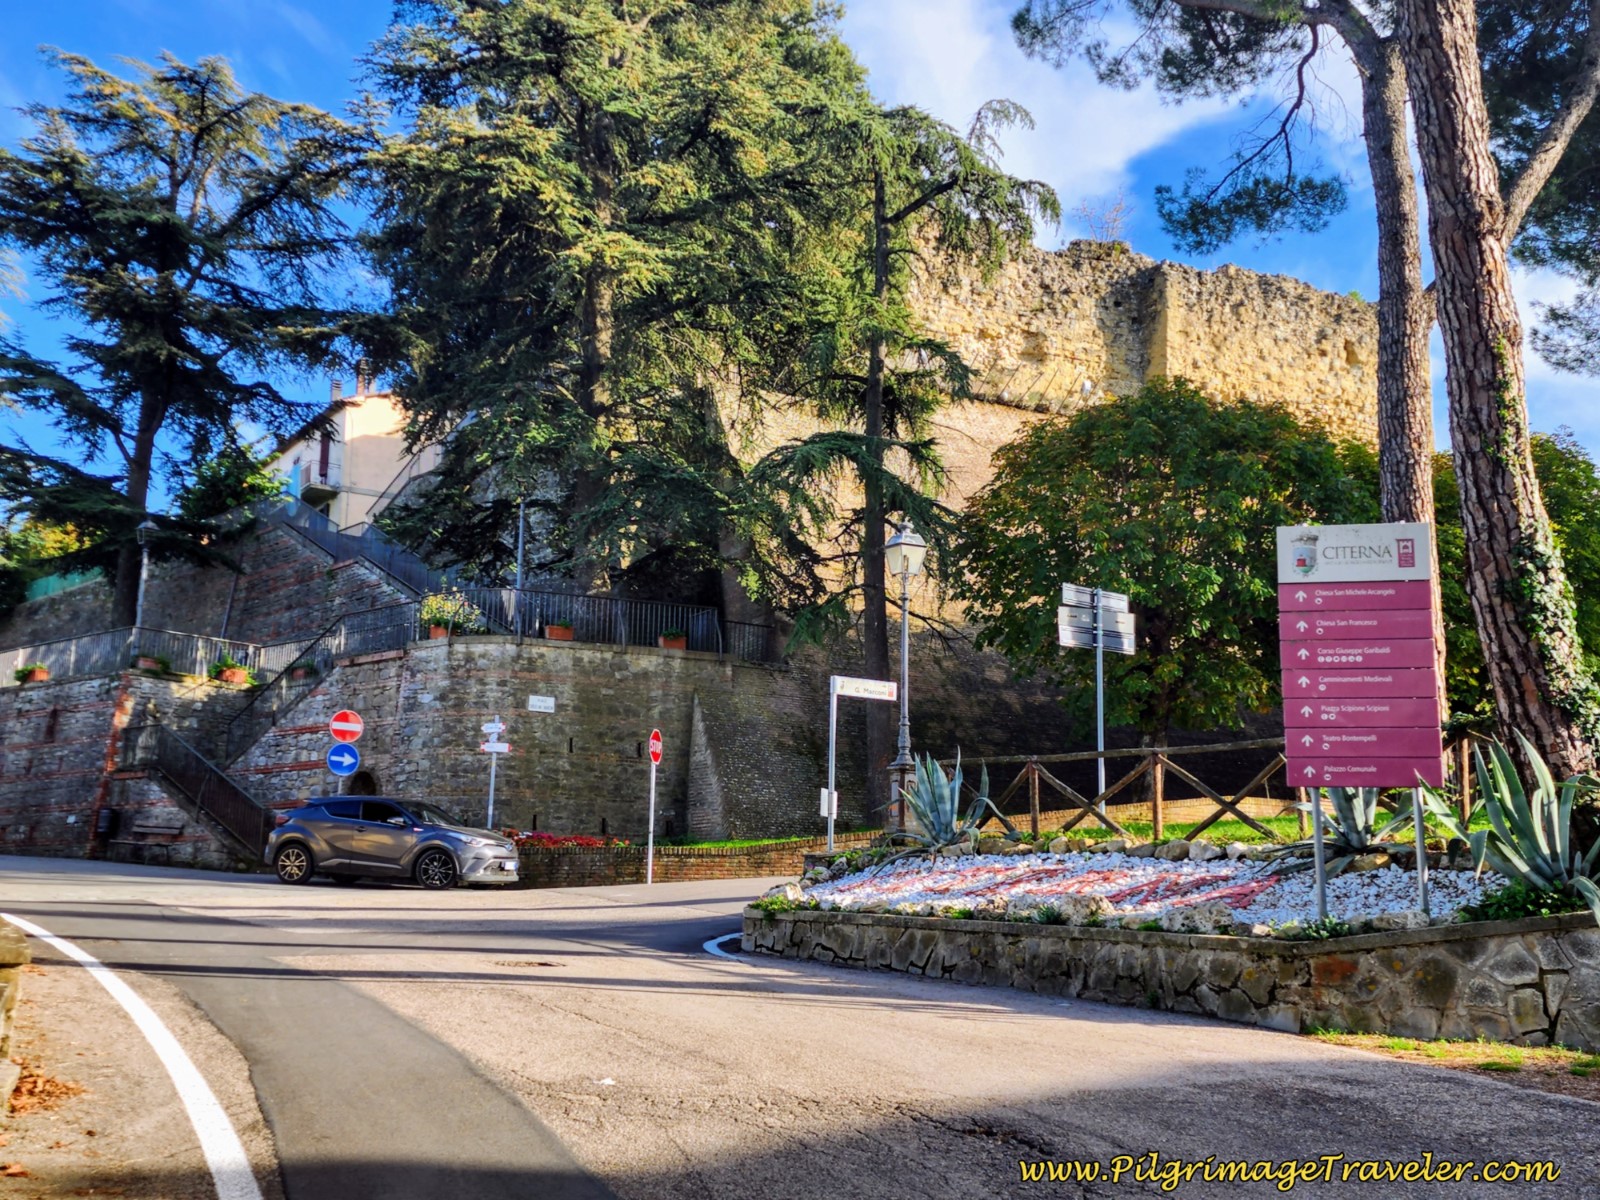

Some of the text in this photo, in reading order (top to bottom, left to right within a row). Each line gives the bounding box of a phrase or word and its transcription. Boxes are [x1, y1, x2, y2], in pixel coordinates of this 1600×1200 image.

[1322, 545, 1393, 560] CITERNA
[1367, 588, 1395, 597] Arcangelo
[1335, 647, 1362, 655] Giuseppe
[1363, 646, 1391, 654] Garibaldi
[863, 687, 887, 696] Marconi
[1342, 734, 1377, 742] Bontempelli
